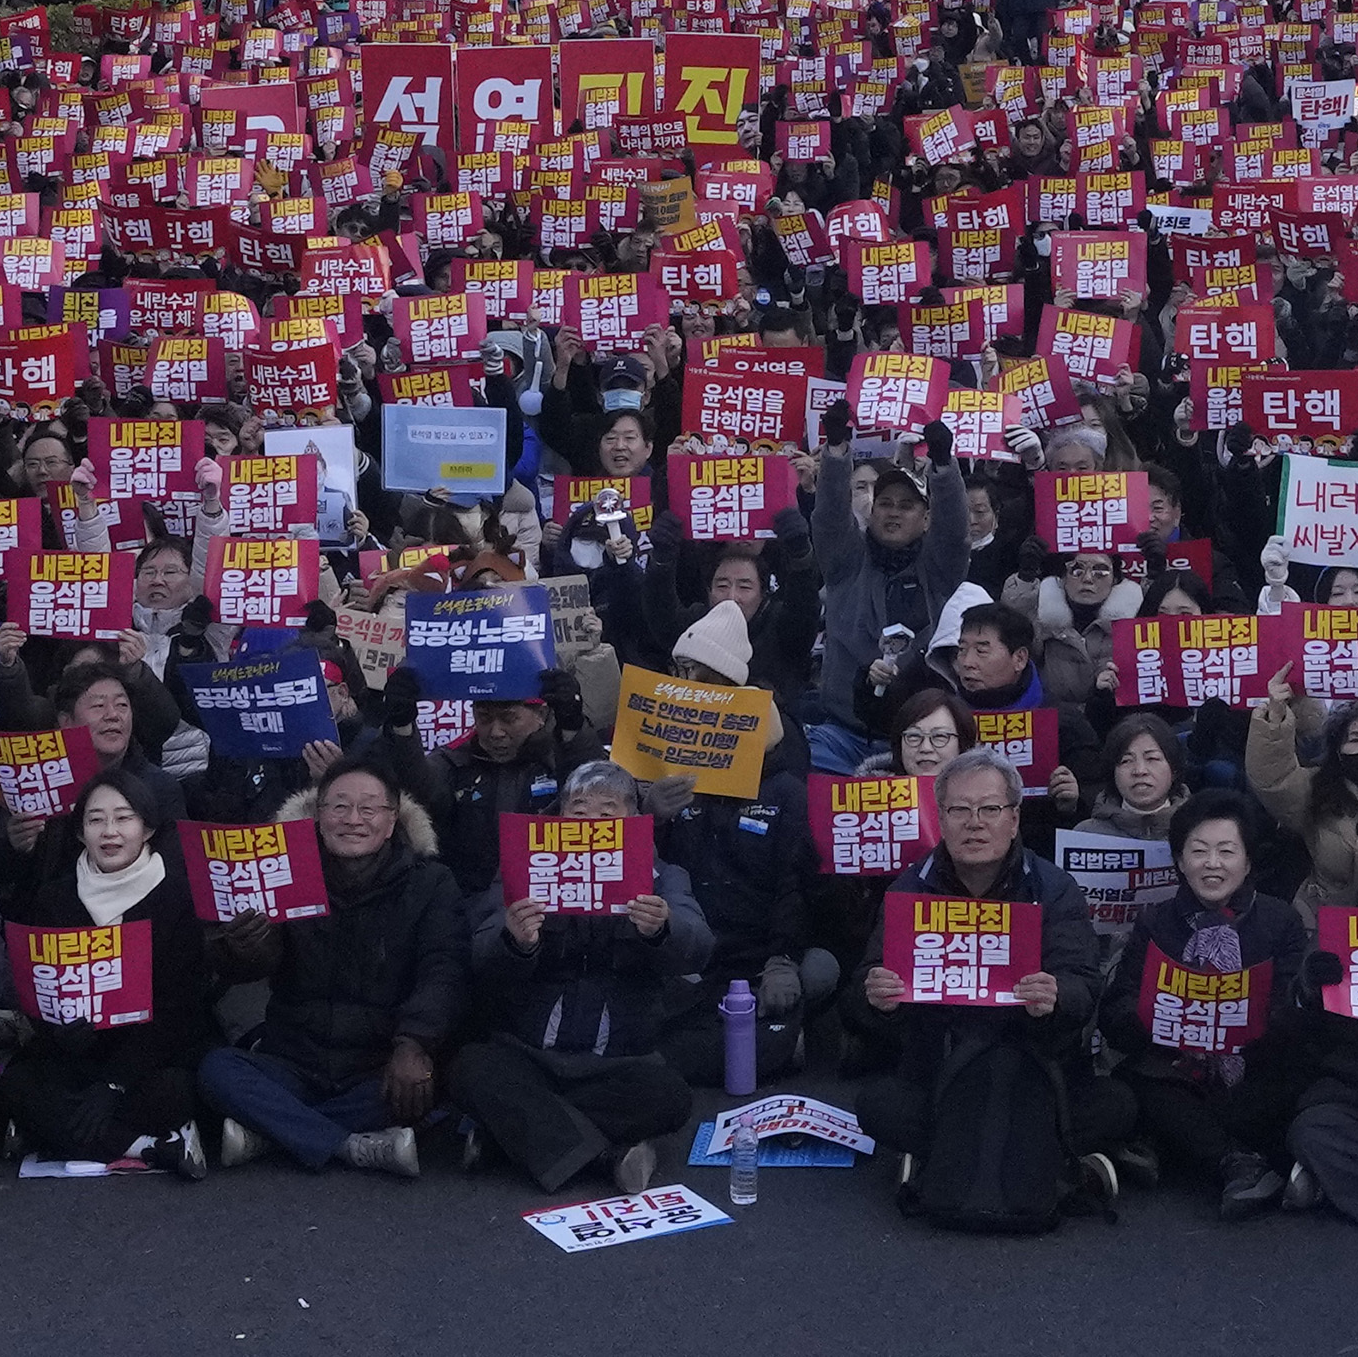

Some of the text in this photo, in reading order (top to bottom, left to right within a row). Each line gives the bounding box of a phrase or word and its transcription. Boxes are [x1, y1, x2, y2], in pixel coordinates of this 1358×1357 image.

[1299, 96, 1348, 120] 탄핵!
[579, 275, 636, 299] 내란죄
[662, 266, 723, 294] 탄핵
[580, 297, 638, 320] 윤석열
[581, 317, 629, 338] 탄핵!
[1190, 321, 1258, 357] 탄핵
[702, 384, 785, 410] 윤석열을
[109, 420, 183, 449] 내란죄
[699, 407, 782, 439] 탄핵하라
[109, 448, 183, 473] 윤석열
[691, 459, 764, 487] 내란죄
[109, 472, 167, 498] 탄핵!
[690, 485, 765, 512] 윤석열
[1056, 475, 1127, 501] 내란죄
[691, 512, 749, 538] 탄핵!
[1056, 500, 1128, 526] 윤석열
[1056, 526, 1113, 550] 탄핵!
[30, 554, 108, 582] 내란죄
[223, 541, 299, 568] 내란죄
[28, 582, 108, 609] 윤석열
[220, 568, 299, 596] 윤석열
[28, 608, 91, 637] 탄핵!
[220, 595, 280, 625] 탄핵!
[408, 615, 546, 645] 공공성·노동권
[450, 648, 502, 672] 확대!
[195, 677, 317, 707] 공공성·노동권
[240, 712, 283, 732] 확대!
[641, 718, 699, 745] 노사합의
[702, 730, 739, 749] 이행!
[663, 745, 733, 768] 임금인상!
[831, 777, 918, 810] 내란죄
[529, 821, 624, 851] 내란죄
[831, 810, 920, 841] 윤석열
[201, 826, 287, 860] 내란죄
[834, 841, 901, 872] 탄핵!
[208, 855, 294, 891] 윤석열
[529, 849, 624, 883] 윤석열
[1068, 850, 1141, 871] 헌법유린
[530, 882, 603, 911] 탄핵!
[914, 901, 1011, 933] 내란죄
[29, 927, 123, 965] 내란죄
[914, 933, 1011, 967] 윤석열
[33, 957, 123, 994] 윤석열
[914, 965, 989, 1000] 탄핵!
[1159, 961, 1250, 1001] 내란죄
[1154, 993, 1250, 1027] 윤석열
[1152, 1016, 1226, 1052] 탄핵!
[583, 1191, 686, 1223] 퇴진!
[568, 1204, 703, 1242] 윤석열
